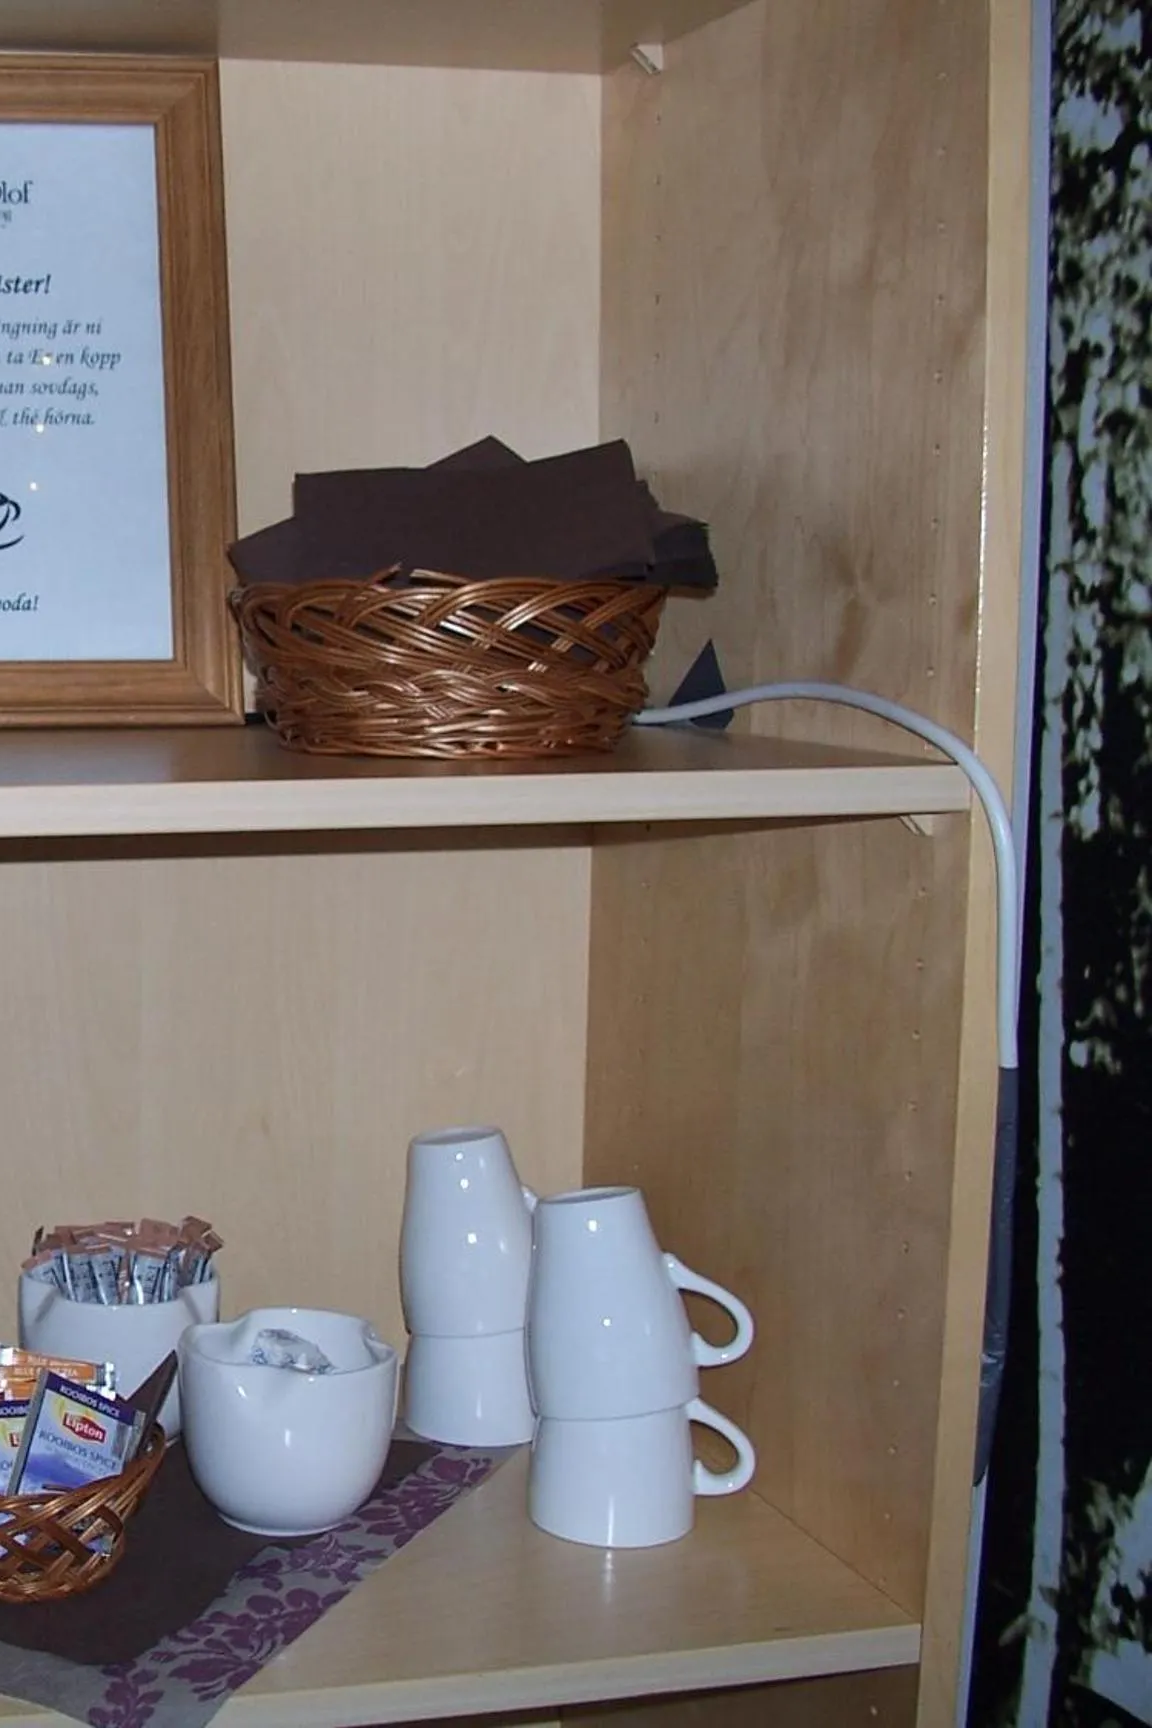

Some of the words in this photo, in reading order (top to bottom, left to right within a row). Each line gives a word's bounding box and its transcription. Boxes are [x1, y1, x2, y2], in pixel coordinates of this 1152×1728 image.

[62, 319, 81, 335] är
[86, 316, 103, 335] ni
[8, 351, 24, 364] ta
[56, 352, 74, 365] en
[80, 345, 121, 370] kopp
[64, 1415, 105, 1441] Lipton
[38, 1429, 88, 1458] ROOIBOS
